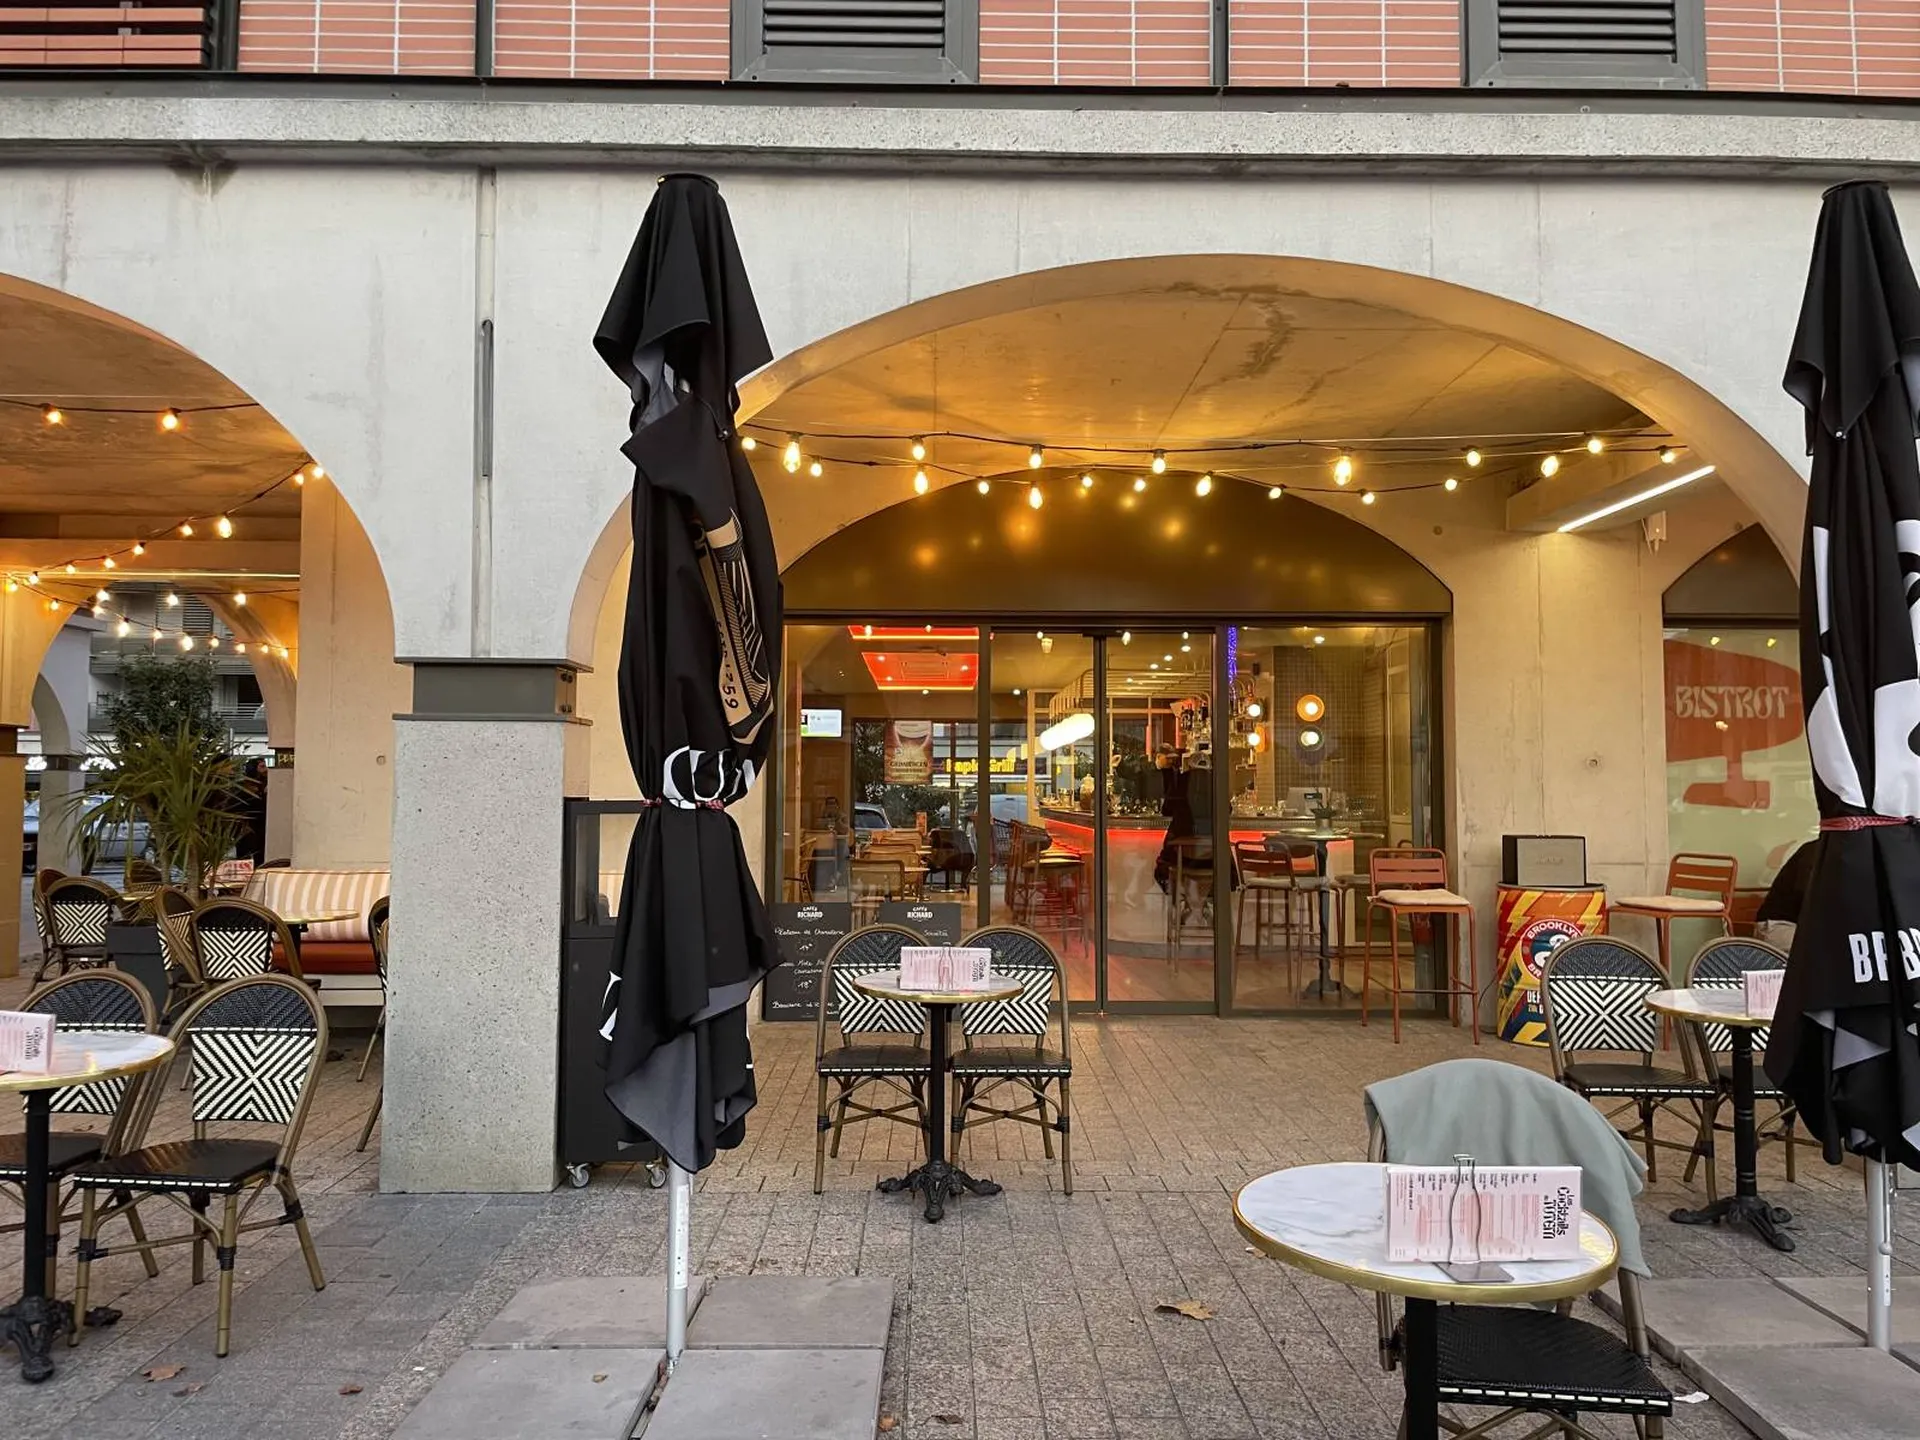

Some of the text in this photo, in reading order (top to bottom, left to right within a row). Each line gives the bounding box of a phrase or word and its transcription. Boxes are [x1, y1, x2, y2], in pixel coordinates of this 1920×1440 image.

[1675, 685, 1790, 719] BISTROT
[797, 911, 824, 919] RICHARD
[906, 911, 933, 919] RICHARD
[1557, 1187, 1570, 1236] Cocktails
